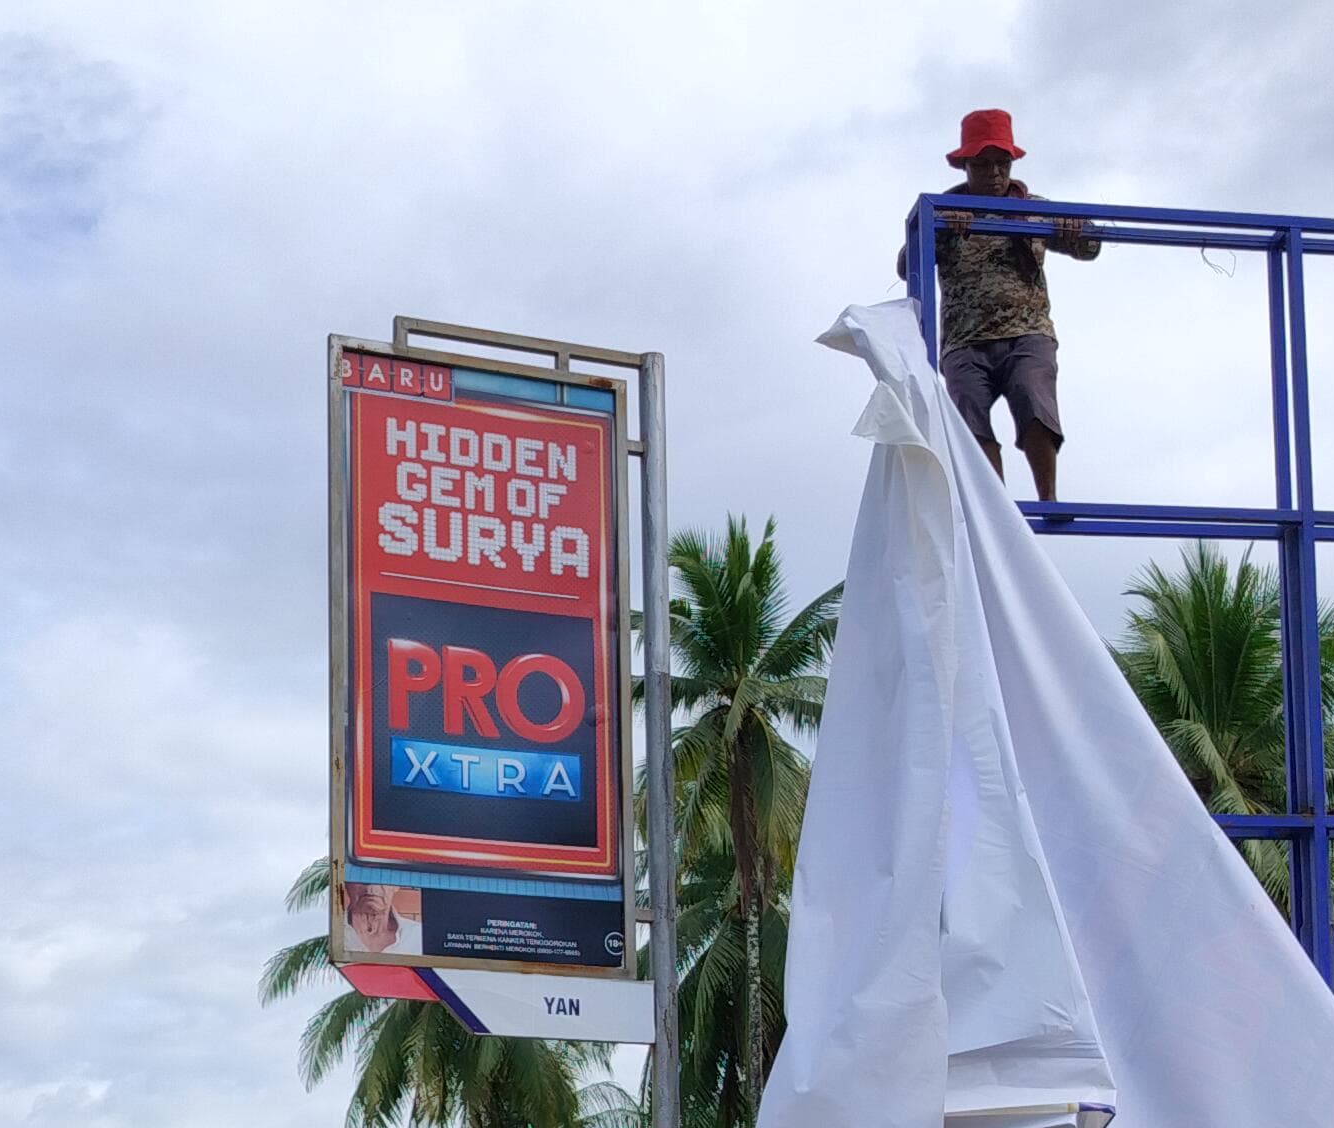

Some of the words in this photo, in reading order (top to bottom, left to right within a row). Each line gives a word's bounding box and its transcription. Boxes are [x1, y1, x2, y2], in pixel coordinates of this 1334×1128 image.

[342, 358, 444, 393] BARU
[385, 416, 578, 482] HIDDEN
[396, 460, 496, 513] GEM
[506, 478, 568, 520] OF
[377, 501, 590, 579] SURYA
[387, 638, 585, 743] PRO
[403, 747, 578, 797] XTRA
[545, 997, 581, 1017] YAN
